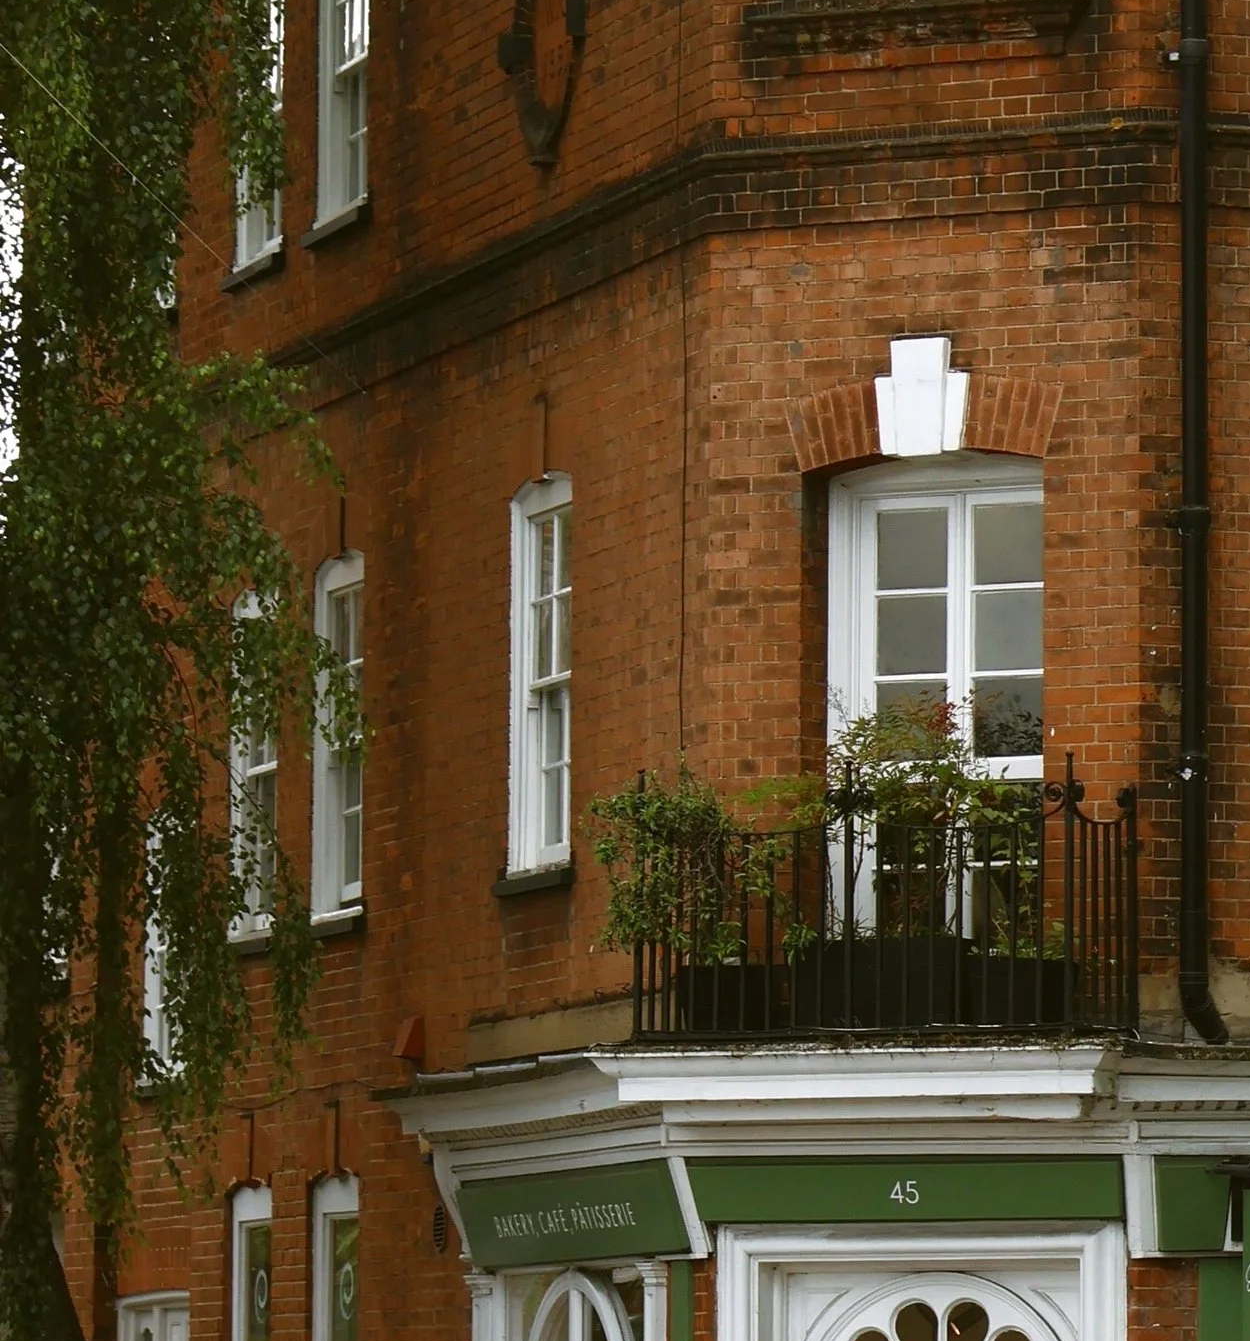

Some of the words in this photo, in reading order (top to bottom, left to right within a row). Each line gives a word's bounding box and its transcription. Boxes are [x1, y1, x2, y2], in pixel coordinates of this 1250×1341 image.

[889, 1180, 920, 1205] 45
[493, 1211, 540, 1238] BAKERY,
[570, 1201, 637, 1231] PÂTISSERIE
